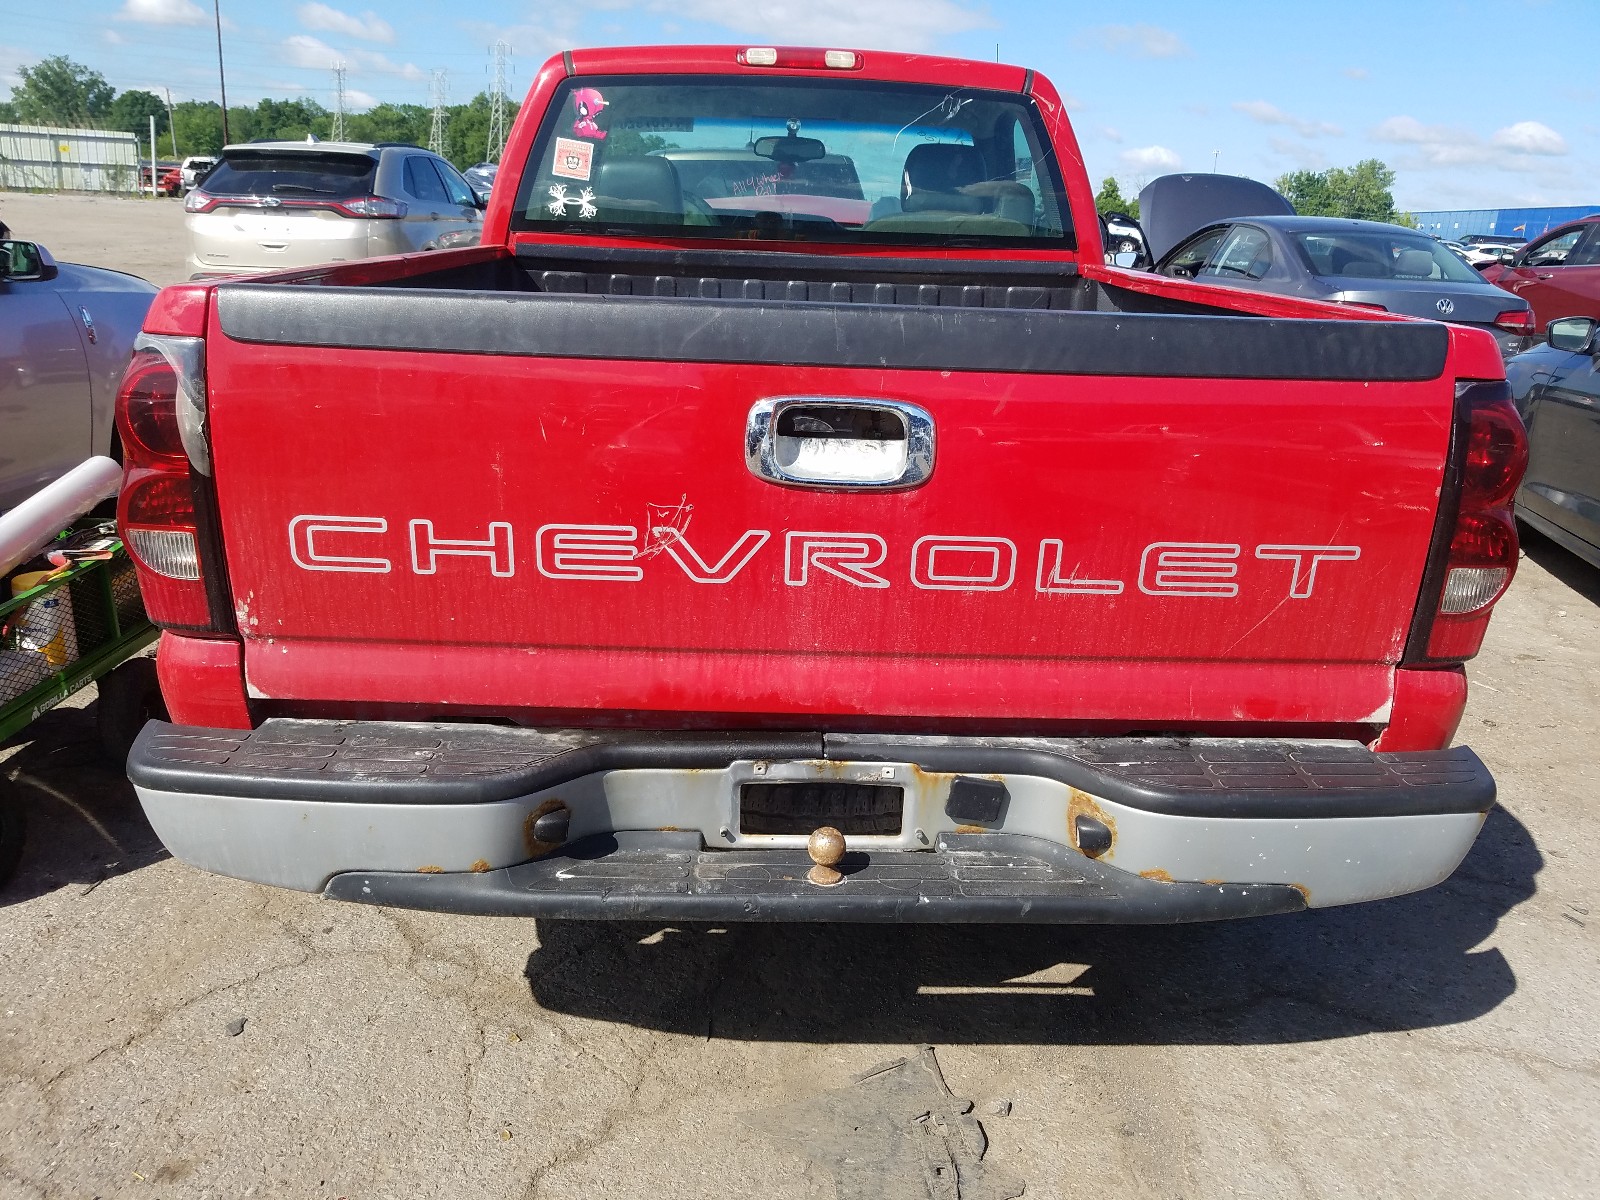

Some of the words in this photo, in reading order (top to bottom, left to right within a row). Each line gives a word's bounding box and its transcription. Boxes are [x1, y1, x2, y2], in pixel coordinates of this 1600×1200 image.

[288, 514, 1361, 598] CHEVROLET
[40, 689, 69, 713] GORILLA
[69, 673, 92, 694] CARTS
